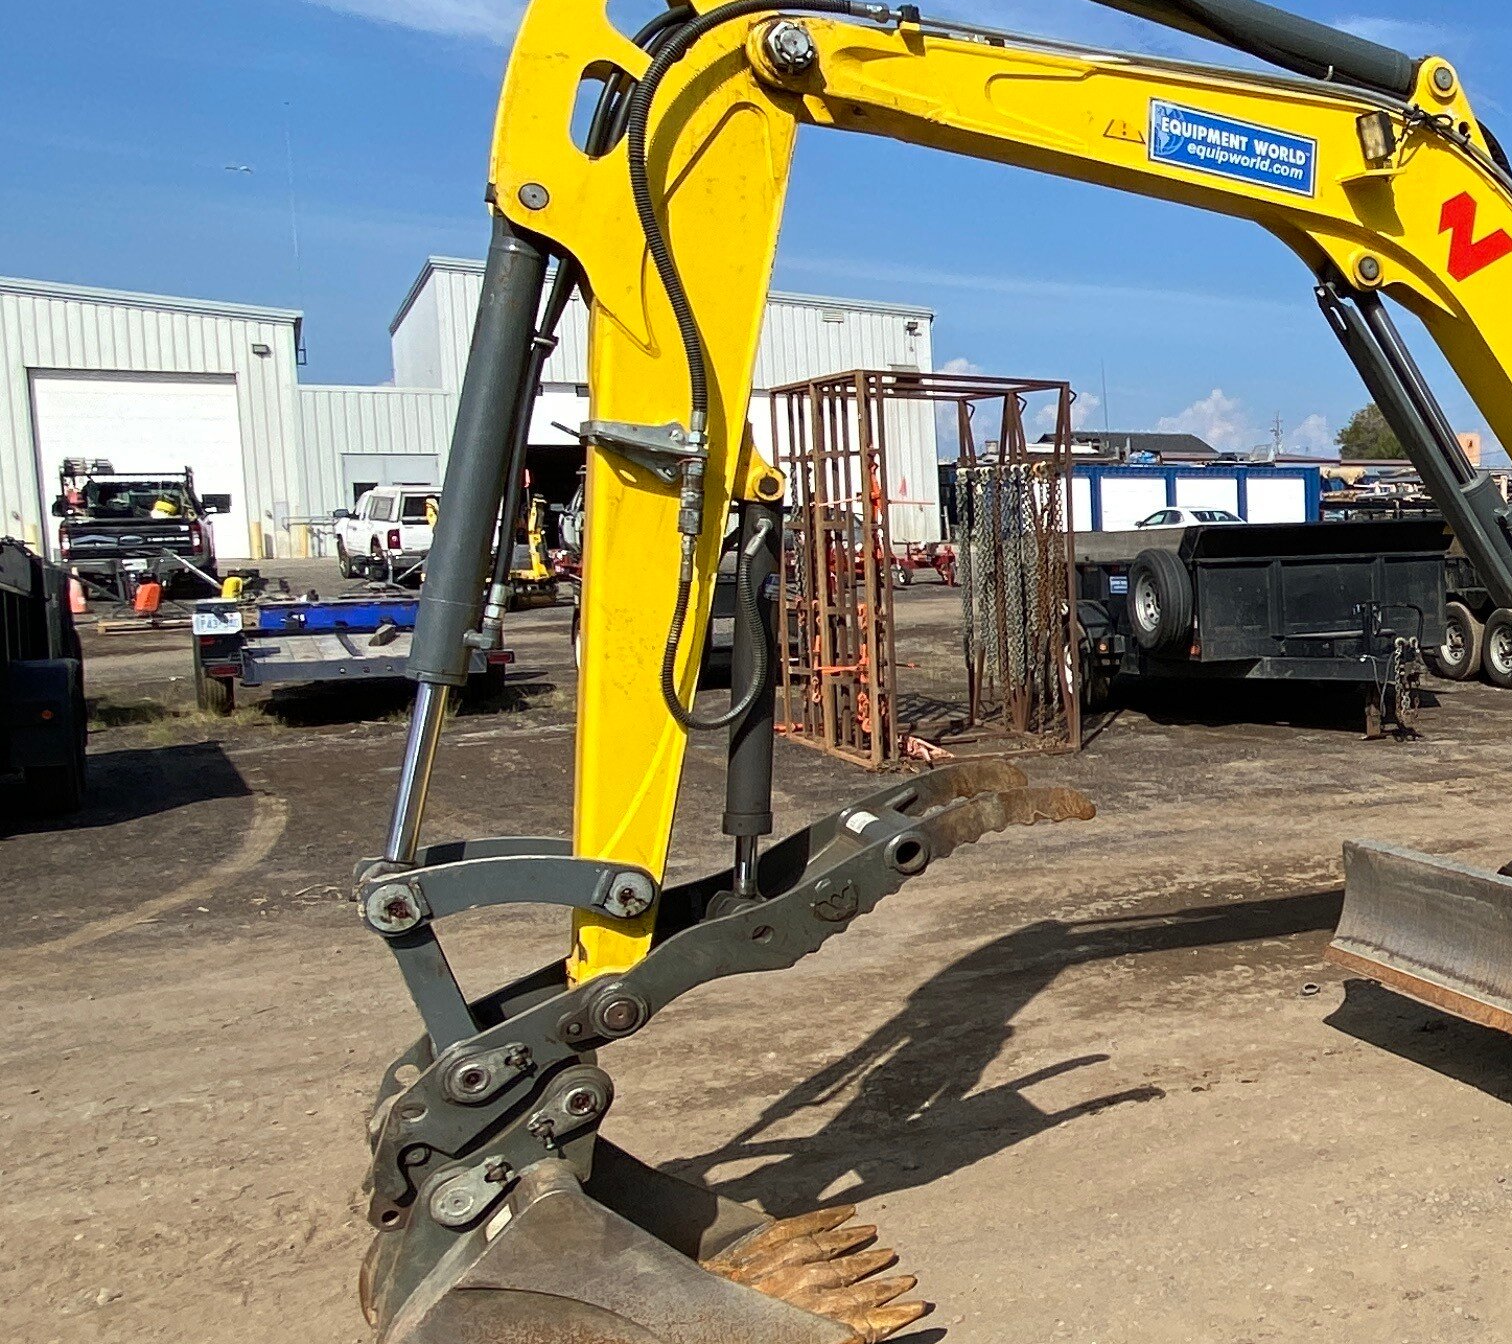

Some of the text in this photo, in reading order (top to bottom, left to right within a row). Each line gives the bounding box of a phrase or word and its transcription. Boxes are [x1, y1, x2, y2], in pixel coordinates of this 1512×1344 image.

[1161, 117, 1306, 165] EQUIPMENT WORLD
[1187, 143, 1304, 181] equipworld.com
